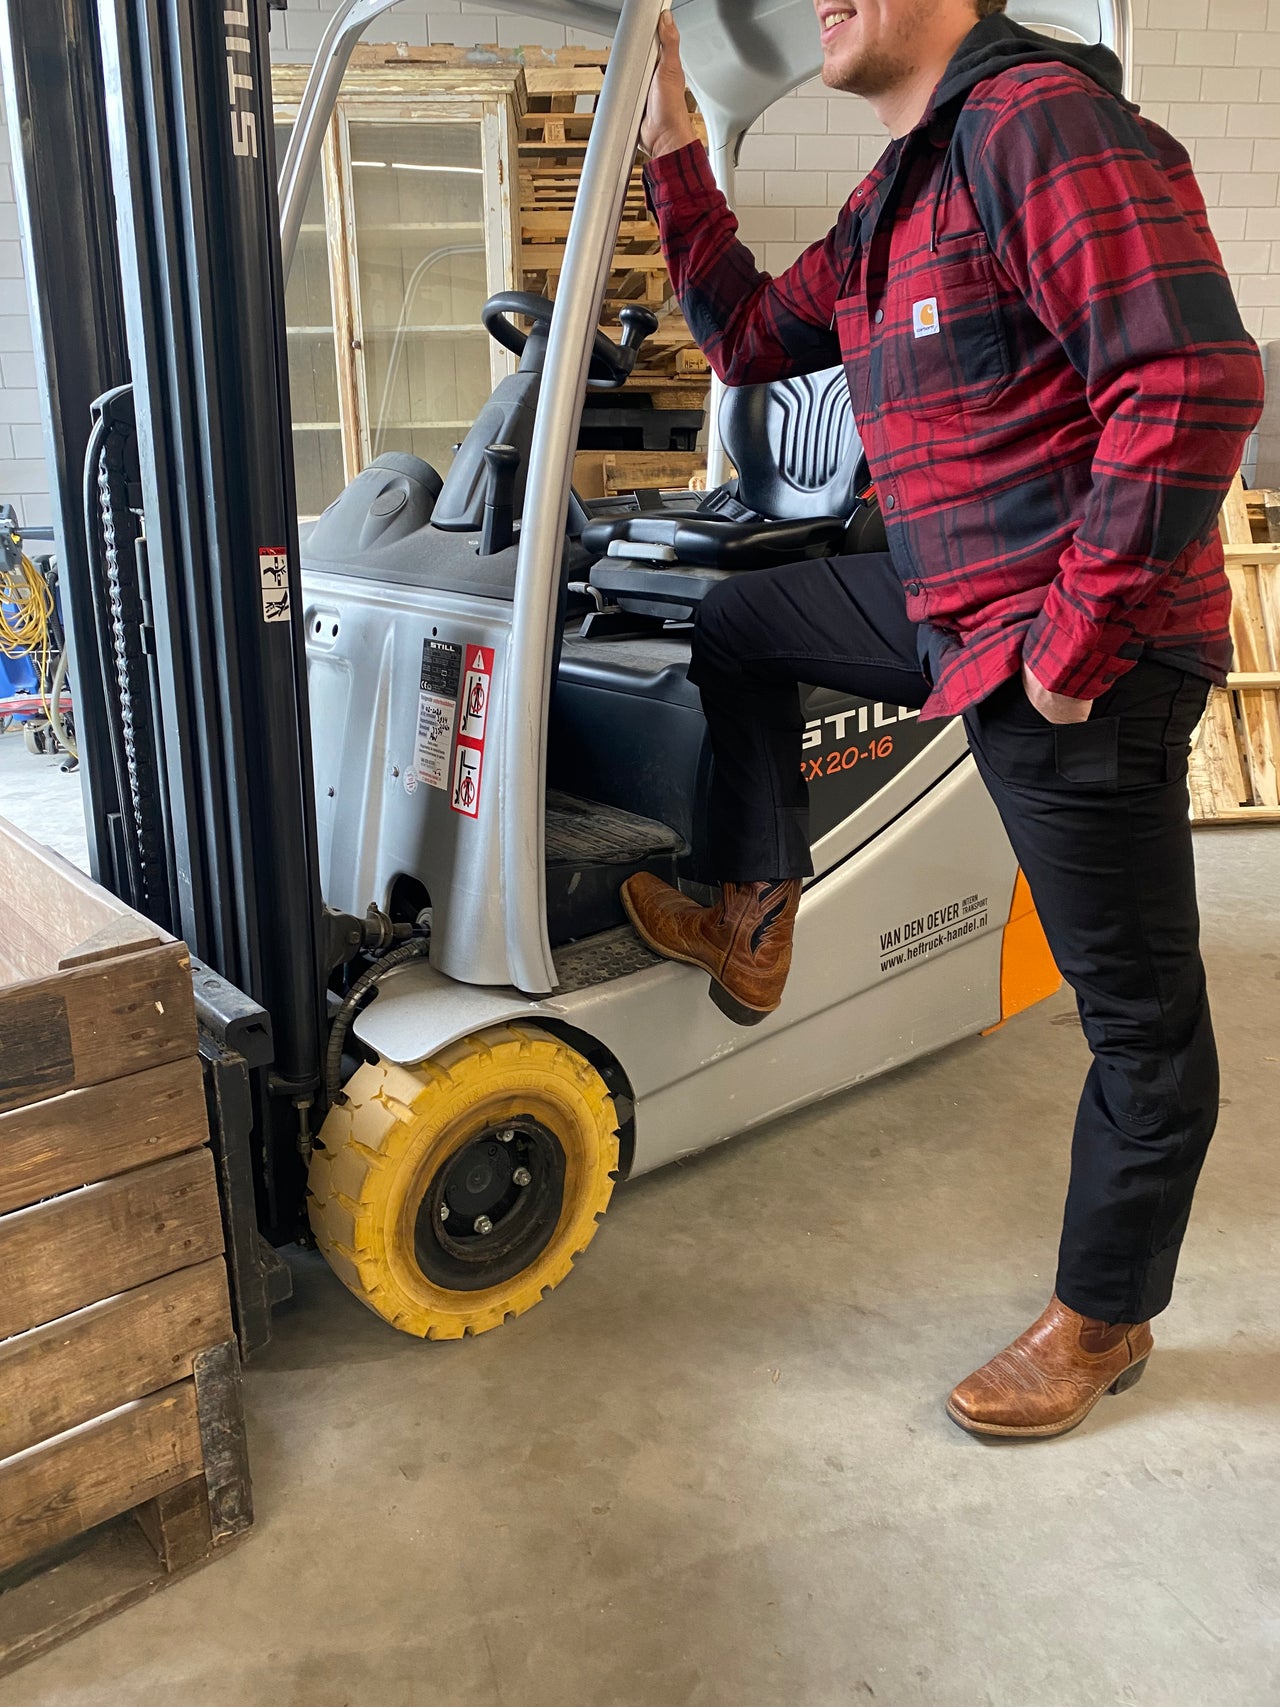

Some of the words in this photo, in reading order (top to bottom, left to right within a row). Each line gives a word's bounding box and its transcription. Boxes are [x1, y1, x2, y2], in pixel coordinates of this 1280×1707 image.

[430, 641, 456, 652] STILL
[961, 893, 979, 907] INTERN
[962, 897, 989, 915] TRANSPORT
[880, 927, 901, 951] VAN
[904, 917, 924, 941] DEN
[927, 902, 960, 931] OEVER
[880, 913, 989, 972] www.heftruck-handel.nl
